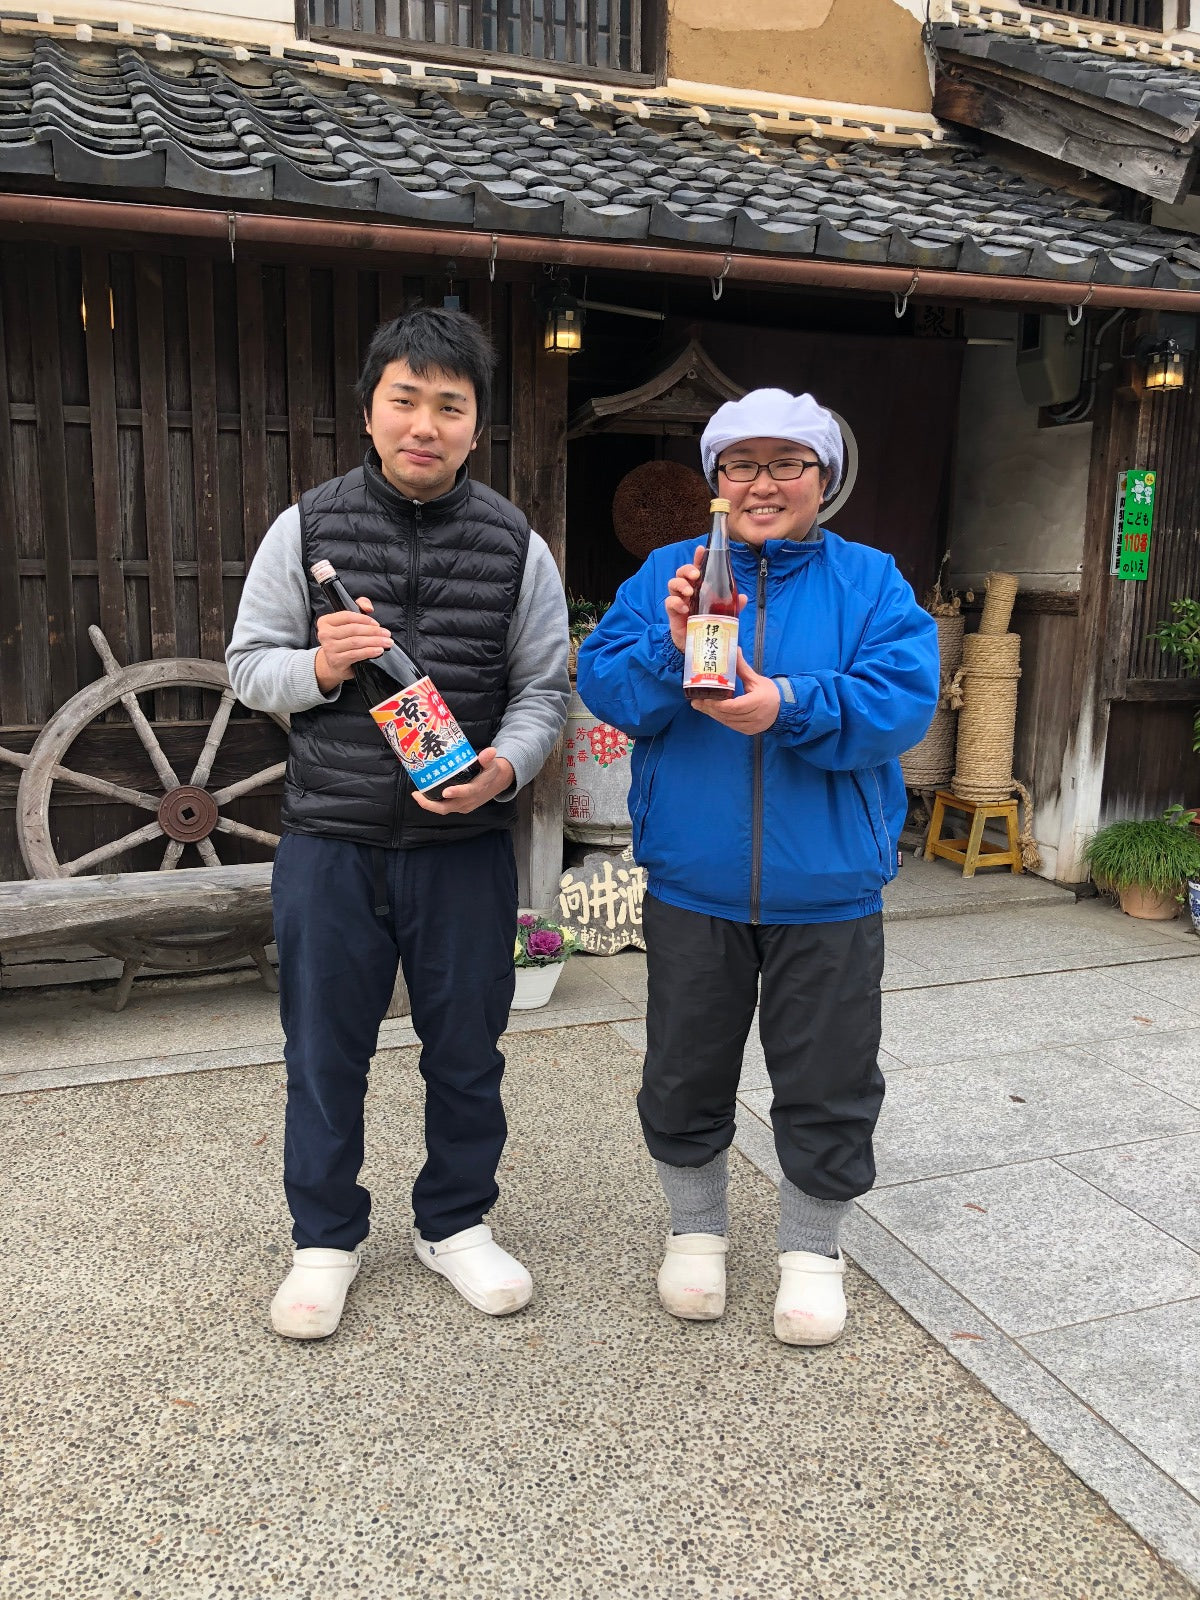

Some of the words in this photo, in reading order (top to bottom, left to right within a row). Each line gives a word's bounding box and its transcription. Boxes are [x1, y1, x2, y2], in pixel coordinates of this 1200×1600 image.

[1127, 512, 1149, 526] こども
[1124, 533, 1148, 553] 110番
[1123, 560, 1144, 573] のいえ
[395, 694, 449, 760] 京の春
[576, 727, 589, 762] 芳香
